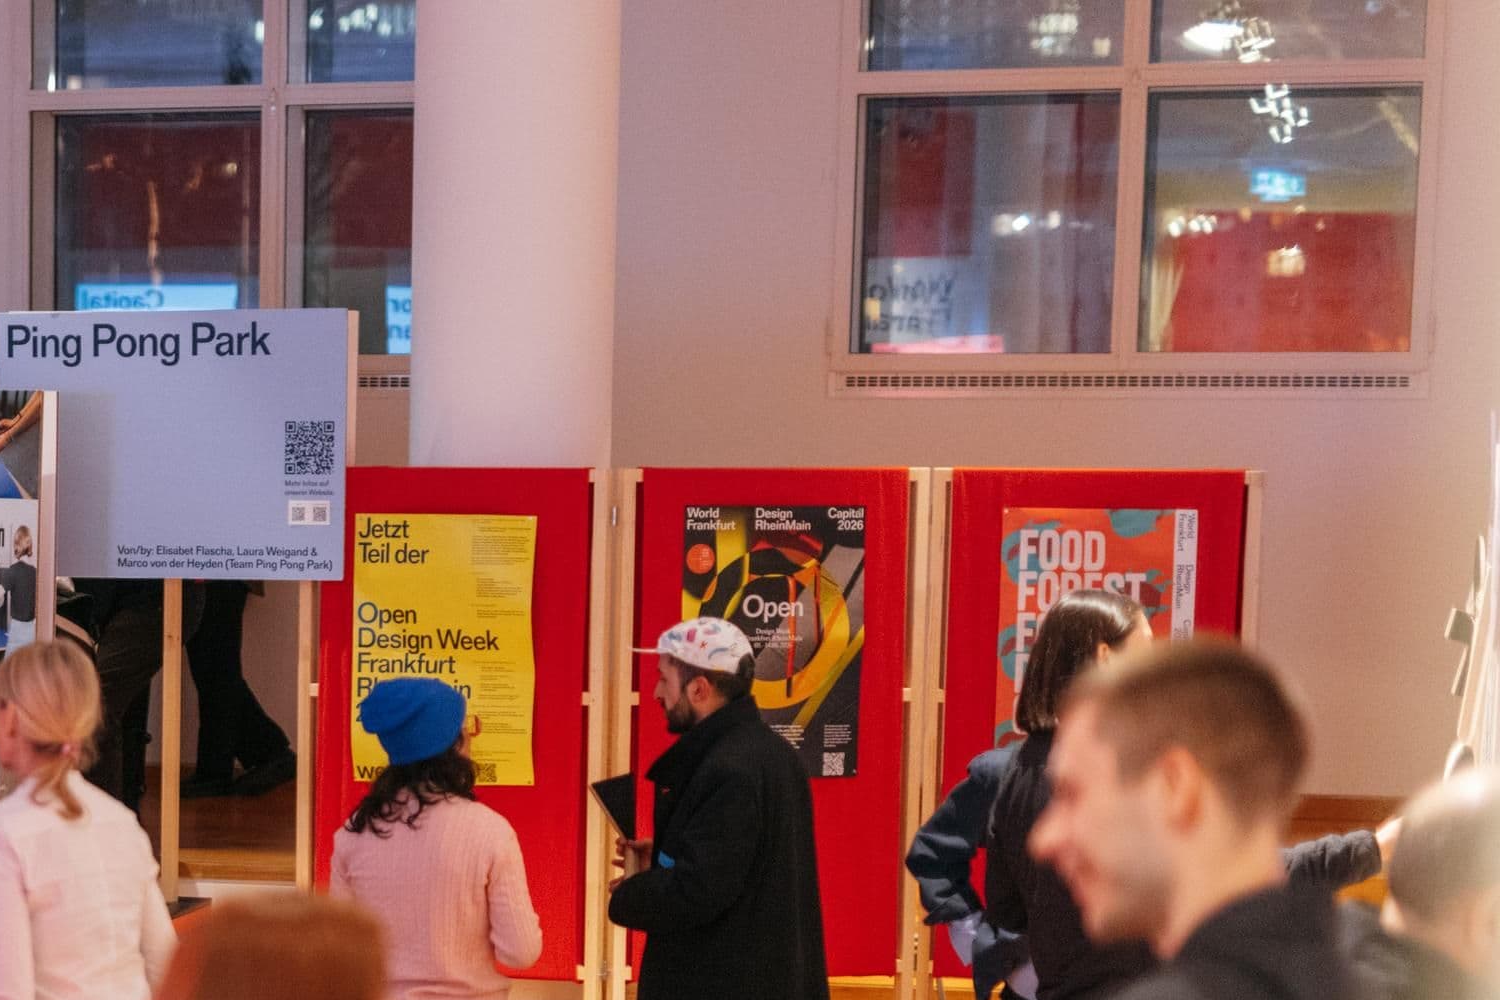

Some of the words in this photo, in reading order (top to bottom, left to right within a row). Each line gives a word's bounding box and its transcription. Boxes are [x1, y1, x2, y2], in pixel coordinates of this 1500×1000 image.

[8, 325, 81, 367] Ping
[93, 323, 180, 366] Pong
[192, 322, 271, 356] Park
[687, 507, 720, 518] World
[755, 507, 793, 520] Design
[828, 507, 864, 519] Capital
[359, 517, 409, 539] Jetzt
[687, 520, 736, 530] Frankfurt
[755, 520, 811, 531] RheinMain
[838, 520, 864, 530] 2026
[117, 545, 154, 557] Von/by:
[156, 545, 194, 555] Elisabet
[196, 546, 234, 557] Flascha,
[237, 547, 264, 556] Laura
[266, 547, 308, 558] Weigand
[310, 548, 317, 556] &
[359, 542, 390, 564] Teil
[395, 543, 429, 564] der
[1019, 529, 1106, 572] FOOD
[118, 558, 148, 568] Marco
[151, 560, 167, 568] von
[169, 559, 184, 568] der
[187, 559, 223, 571] Heyden
[225, 558, 253, 571] (Team
[256, 559, 277, 571] Ping
[280, 560, 304, 572] Pong
[307, 560, 333, 571] Park)
[358, 602, 416, 628] Open
[743, 594, 804, 623] Open
[358, 628, 432, 654] Design
[437, 629, 499, 650] Week
[357, 652, 456, 673] Frankfurt
